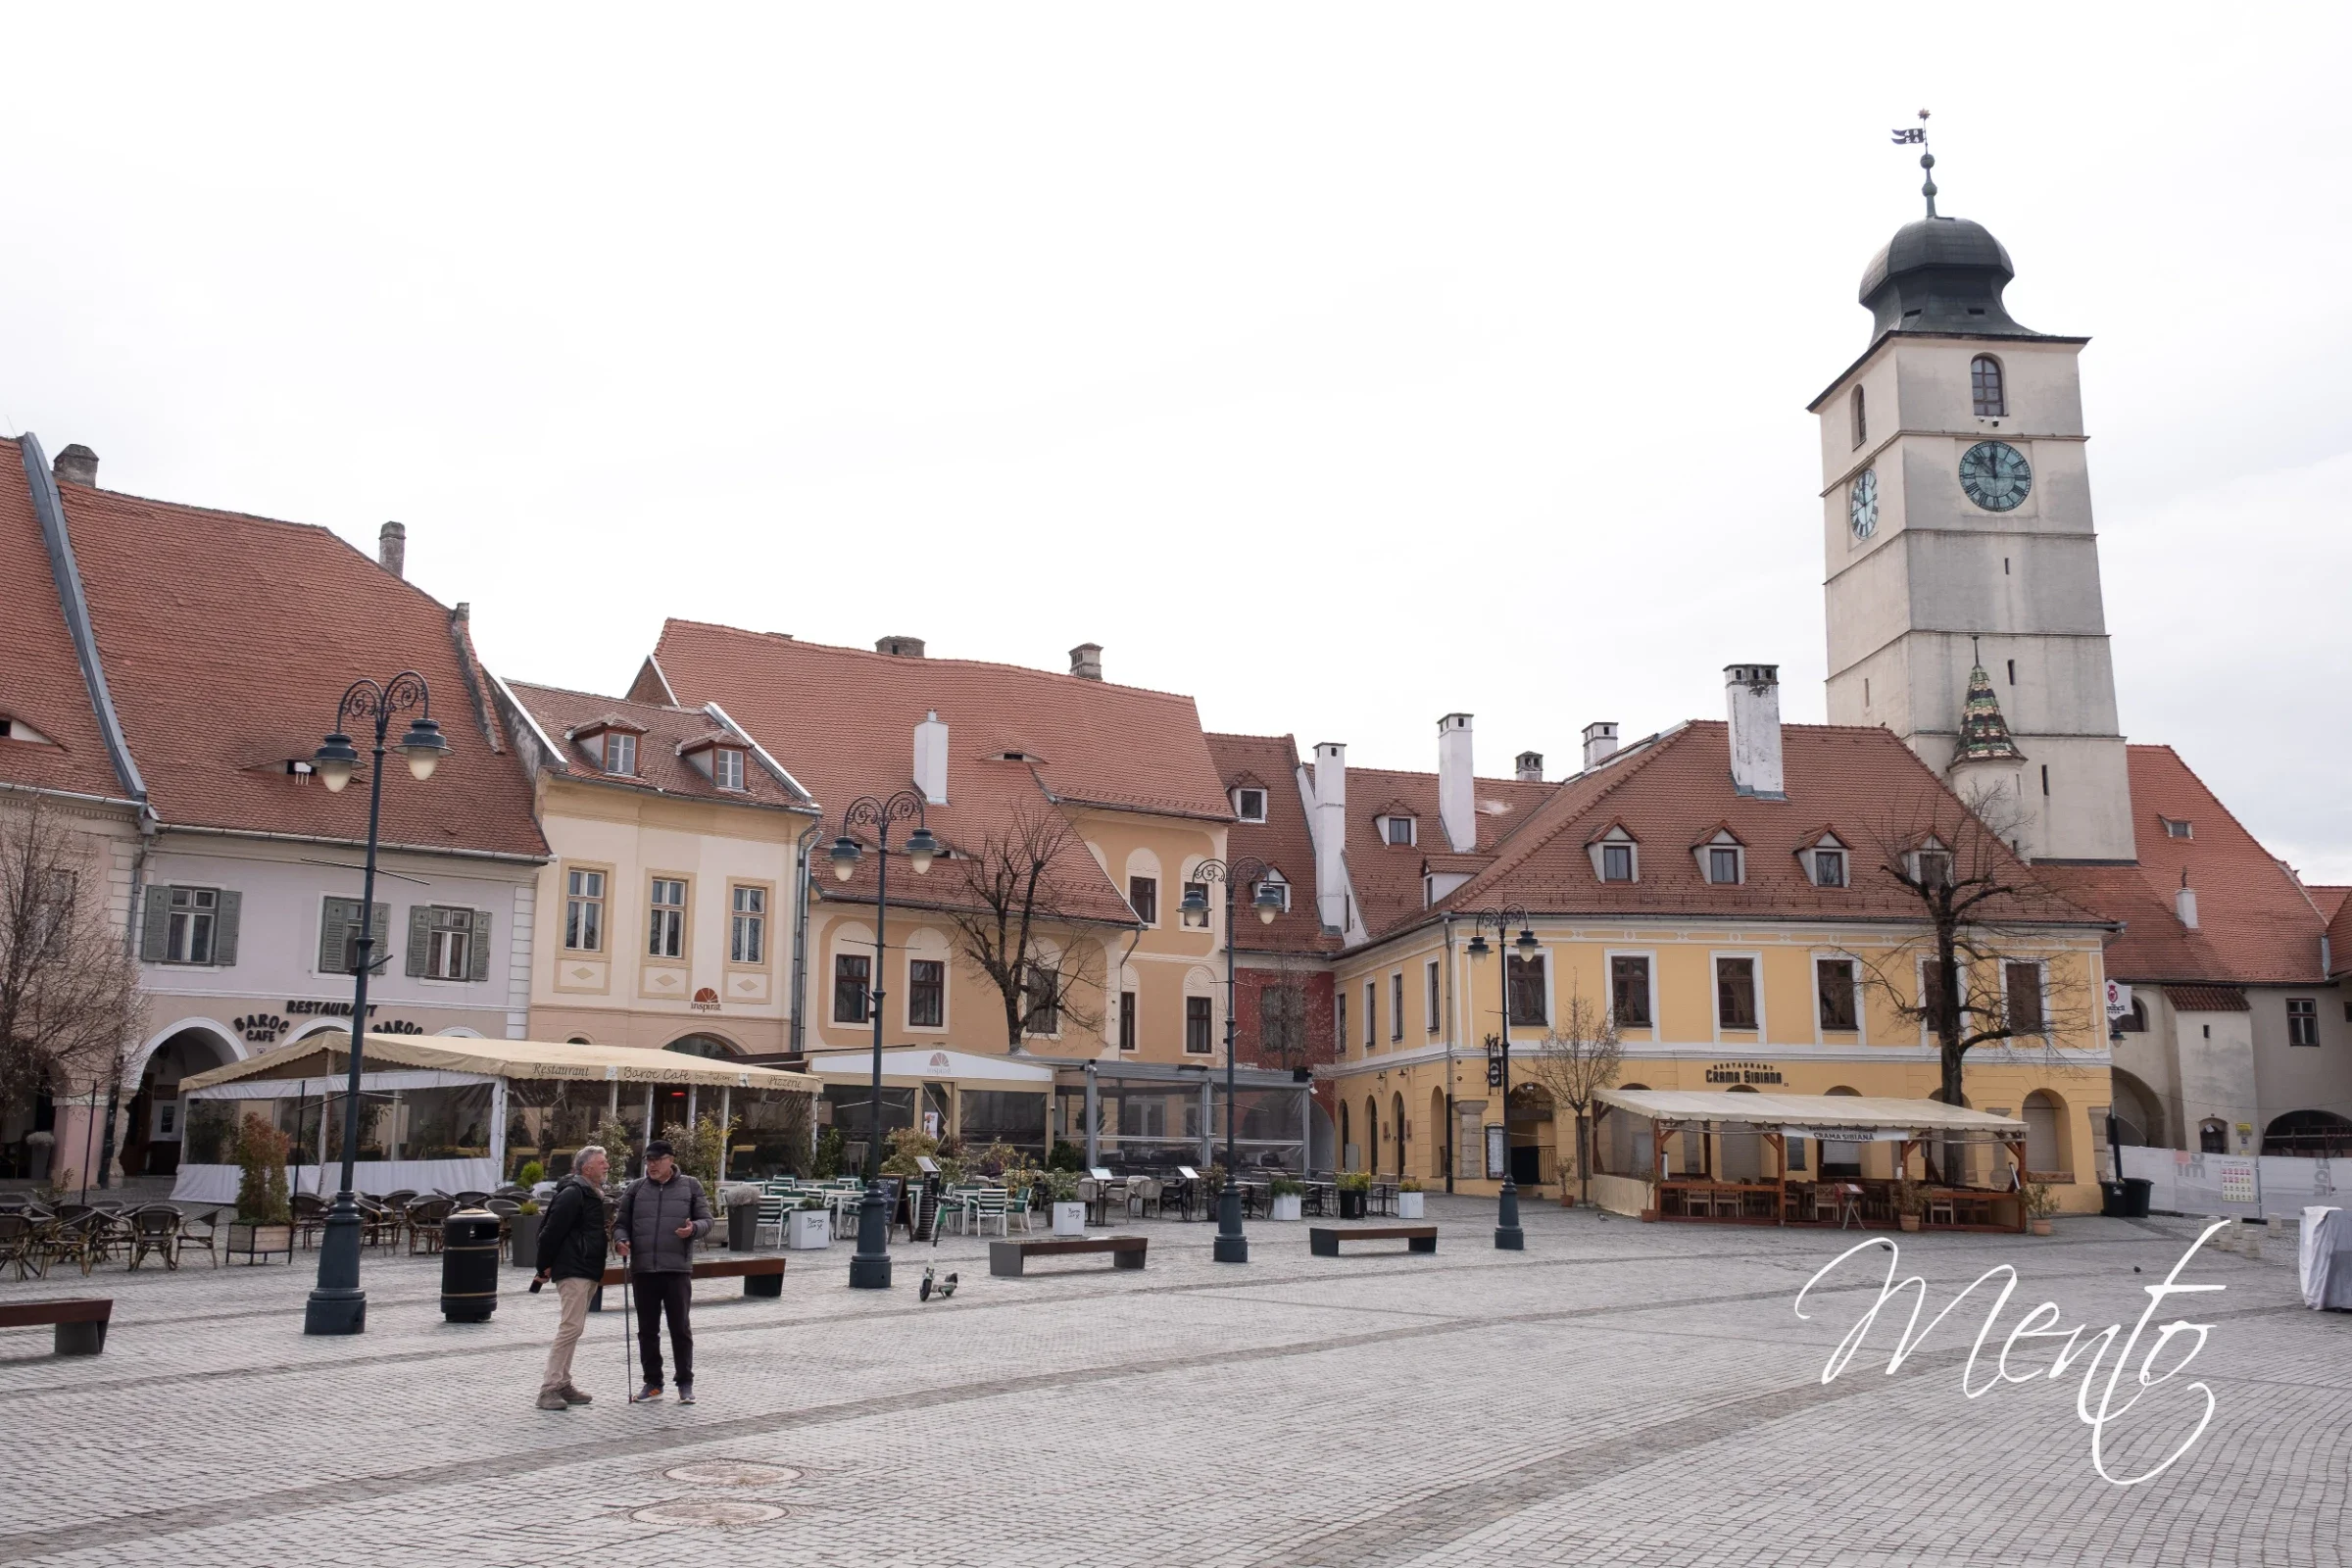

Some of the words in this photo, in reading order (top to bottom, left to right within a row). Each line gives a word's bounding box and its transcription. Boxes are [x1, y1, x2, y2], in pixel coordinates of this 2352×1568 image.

[286, 1000, 377, 1017] RESTAURAT
[233, 1013, 290, 1034] BAROC
[246, 1030, 275, 1043] CAFE
[532, 1062, 589, 1077] Restaurant
[623, 1066, 661, 1079] Baroc
[1713, 1062, 1774, 1071] RESTAURANT
[767, 1074, 803, 1090] Pizzerie
